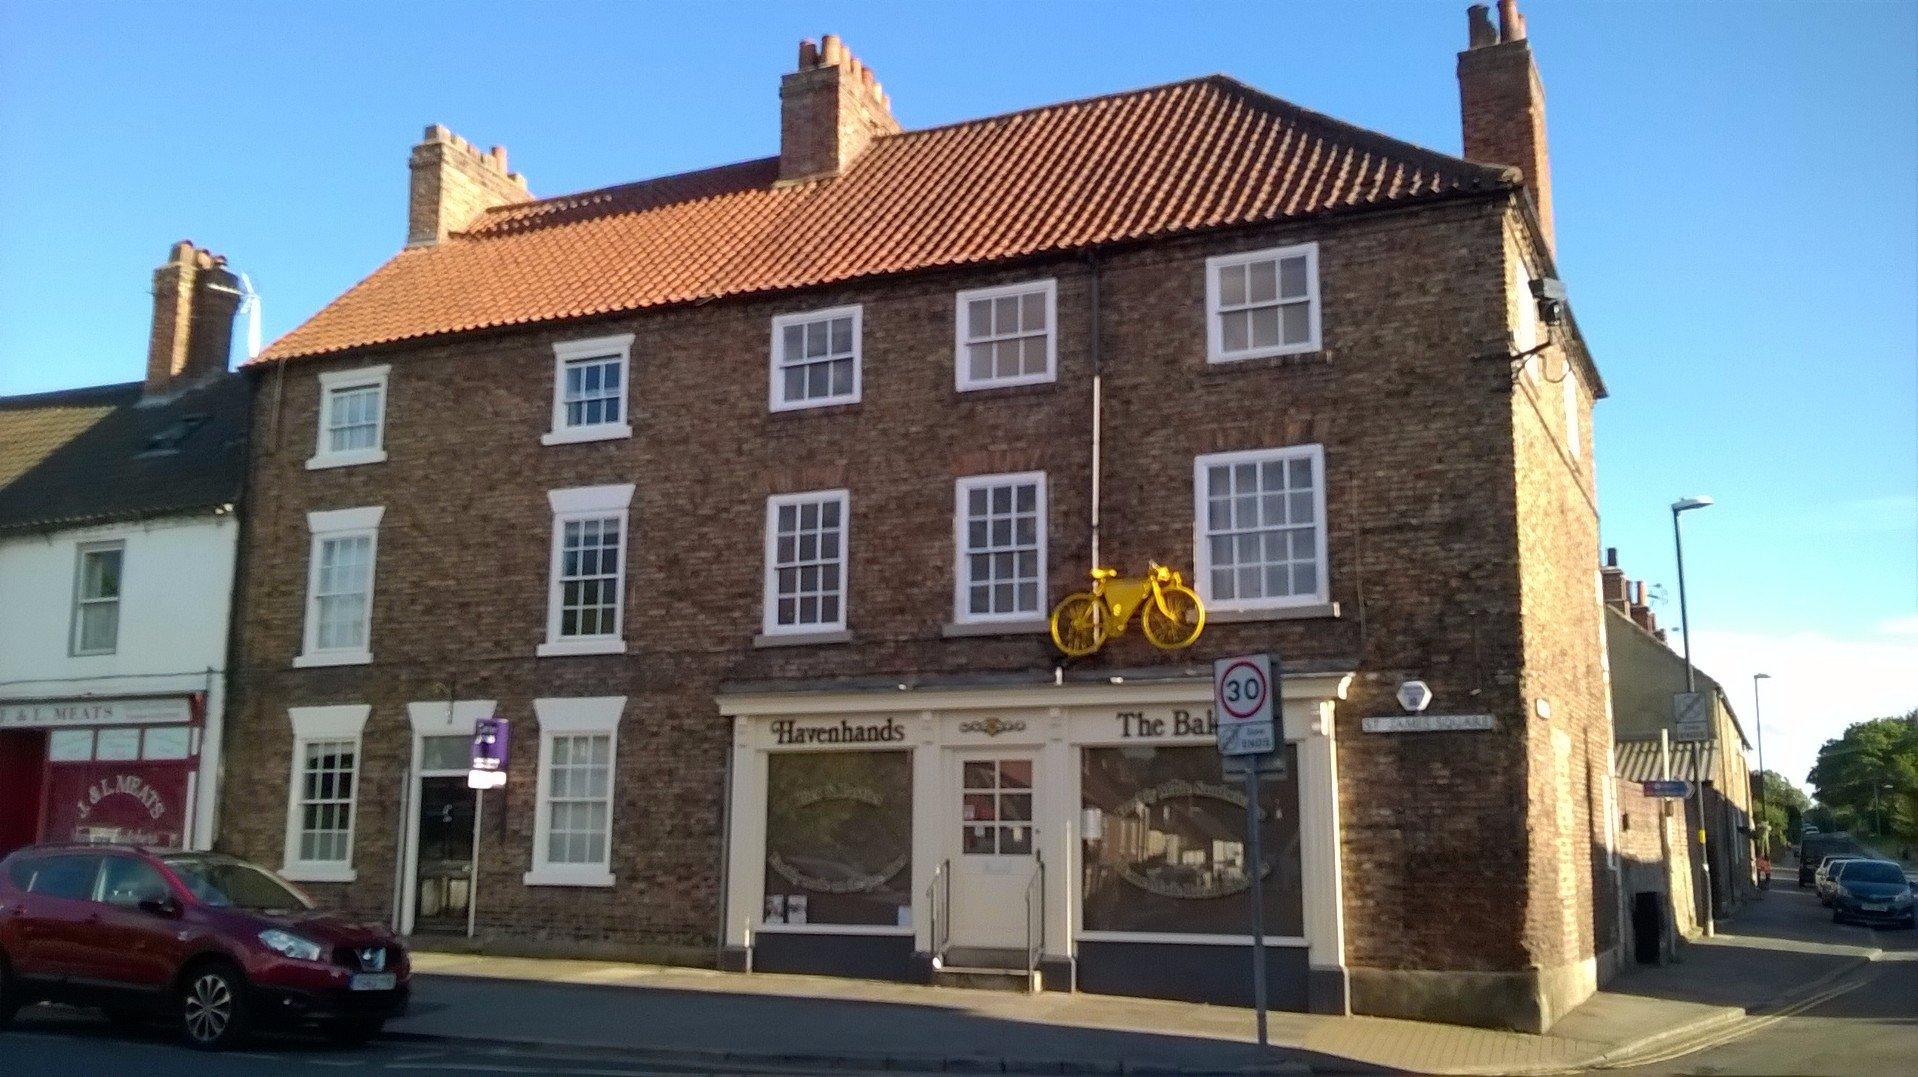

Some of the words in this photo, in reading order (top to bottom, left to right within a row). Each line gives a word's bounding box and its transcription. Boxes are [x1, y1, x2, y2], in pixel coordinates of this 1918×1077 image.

[1226, 678, 1259, 702] 30
[54, 704, 113, 720] MEATS
[1116, 711, 1164, 737] The
[771, 717, 905, 744] Havenhands
[115, 775, 165, 819] MEATS
